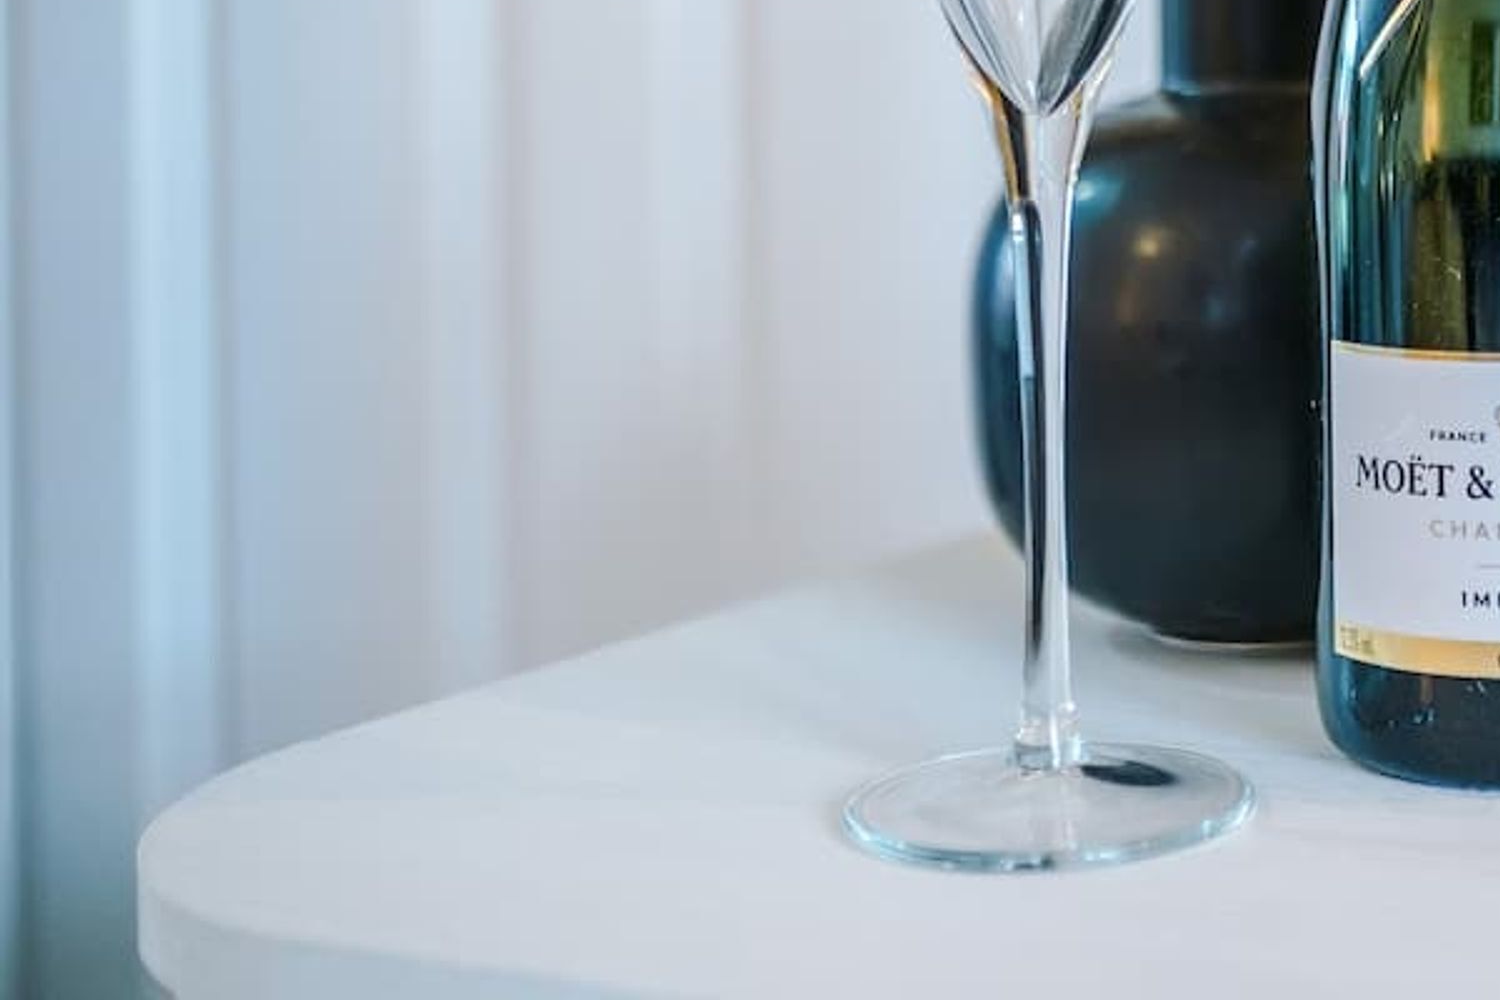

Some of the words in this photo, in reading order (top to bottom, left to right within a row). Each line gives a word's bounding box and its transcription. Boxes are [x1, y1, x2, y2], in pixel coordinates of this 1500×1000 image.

[1429, 428, 1488, 444] FRANCE
[1355, 453, 1455, 497] MOËT
[1465, 464, 1494, 500] &
